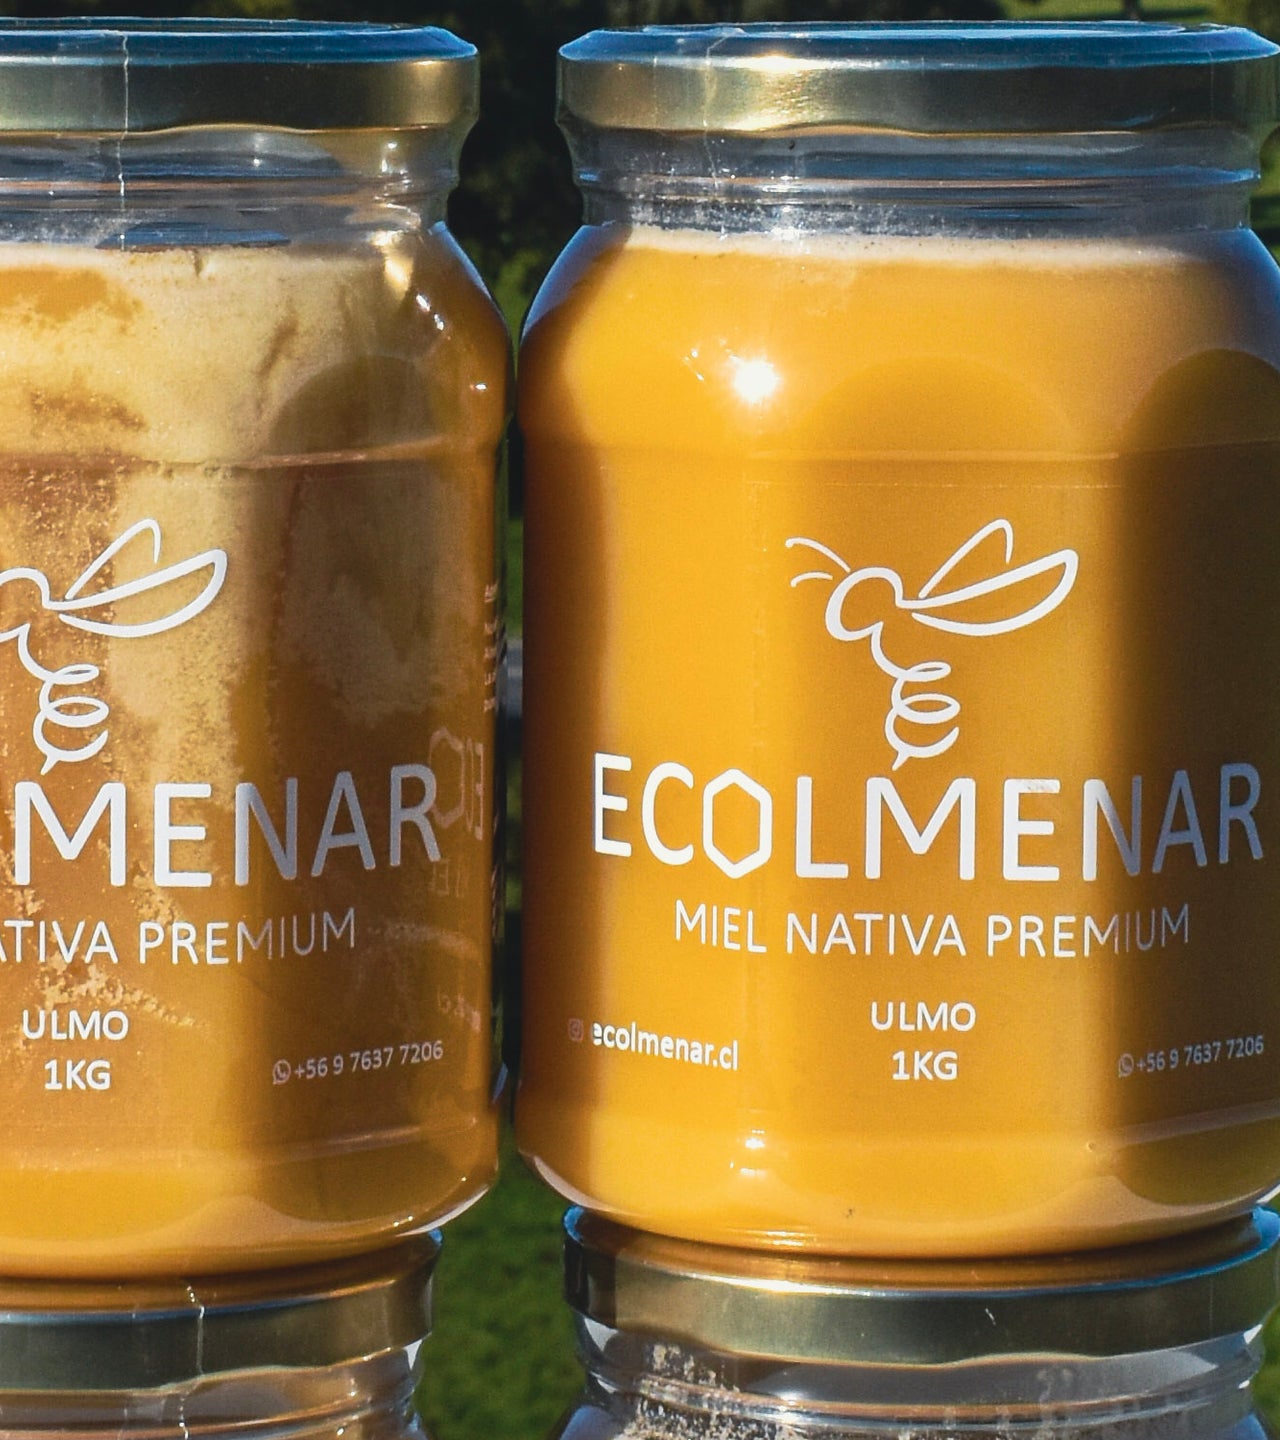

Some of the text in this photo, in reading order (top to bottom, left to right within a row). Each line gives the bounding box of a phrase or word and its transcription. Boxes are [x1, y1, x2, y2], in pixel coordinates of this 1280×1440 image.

[592, 751, 1265, 882] ECOLMENAR
[139, 907, 356, 965] PREMIUM
[675, 899, 1191, 958] MIEL NATIVA PREMIUM
[22, 1008, 129, 1042] ULMO
[871, 1001, 977, 1033] ULMO
[295, 1040, 444, 1080] +56 9 7637 7206
[892, 1051, 959, 1081] 1KG
[1137, 1035, 1264, 1073] +56 9 7637 7206
[44, 1060, 111, 1091] 1KG
